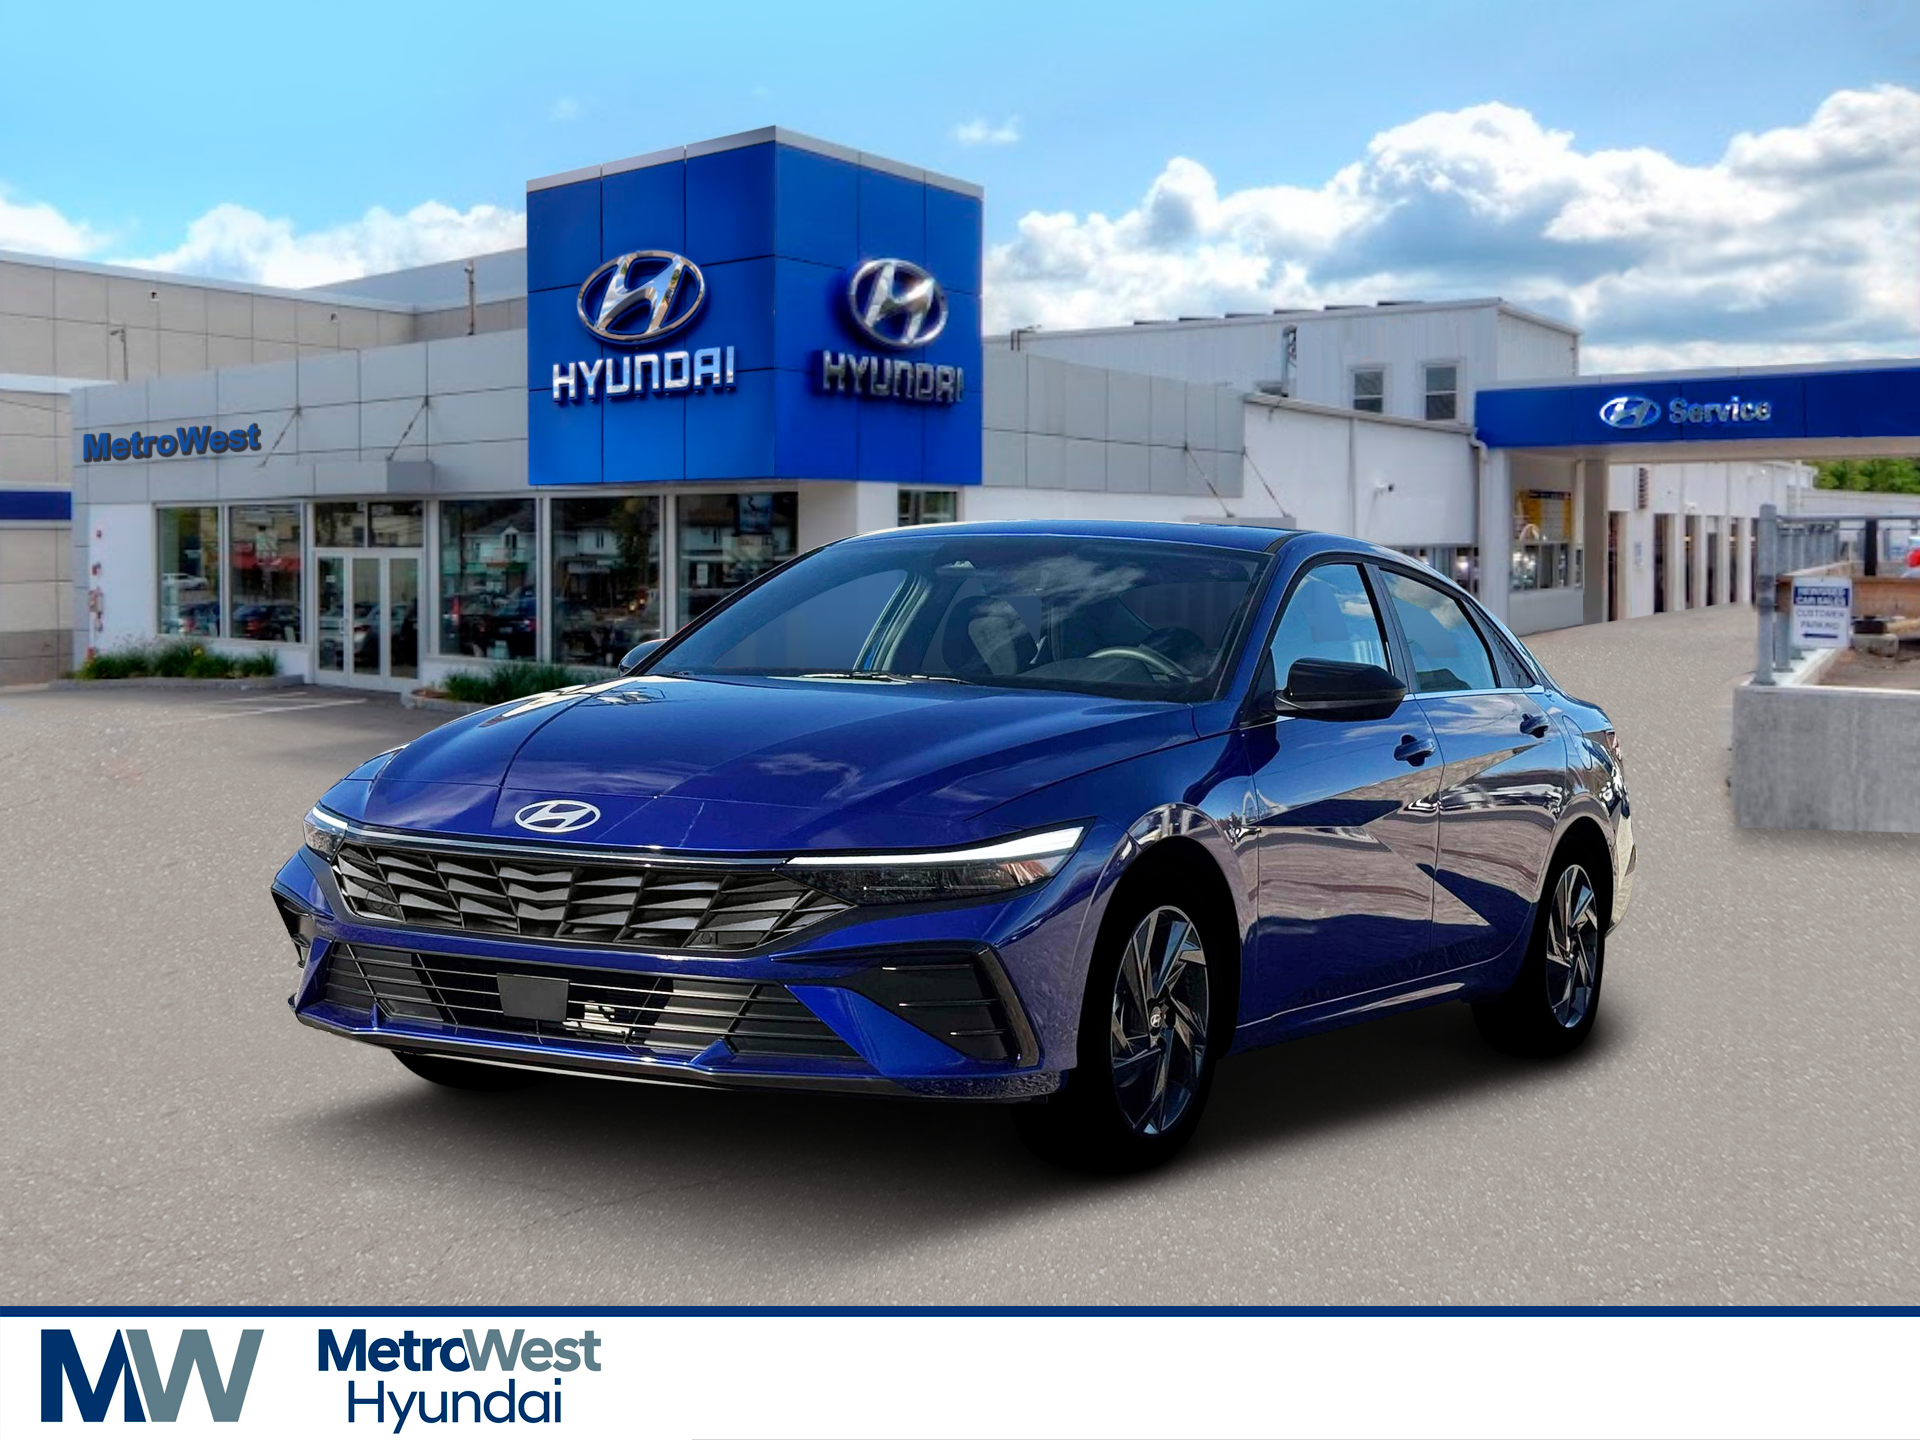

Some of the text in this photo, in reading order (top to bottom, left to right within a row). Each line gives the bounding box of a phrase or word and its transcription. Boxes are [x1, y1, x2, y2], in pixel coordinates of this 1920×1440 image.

[552, 345, 736, 402] HYUNDAI
[822, 350, 965, 403] HYUNDAI
[1668, 395, 1772, 424] Service
[83, 422, 262, 463] MetroWest
[1796, 608, 1845, 618] CUSTOMER
[1800, 620, 1839, 630] PARKING
